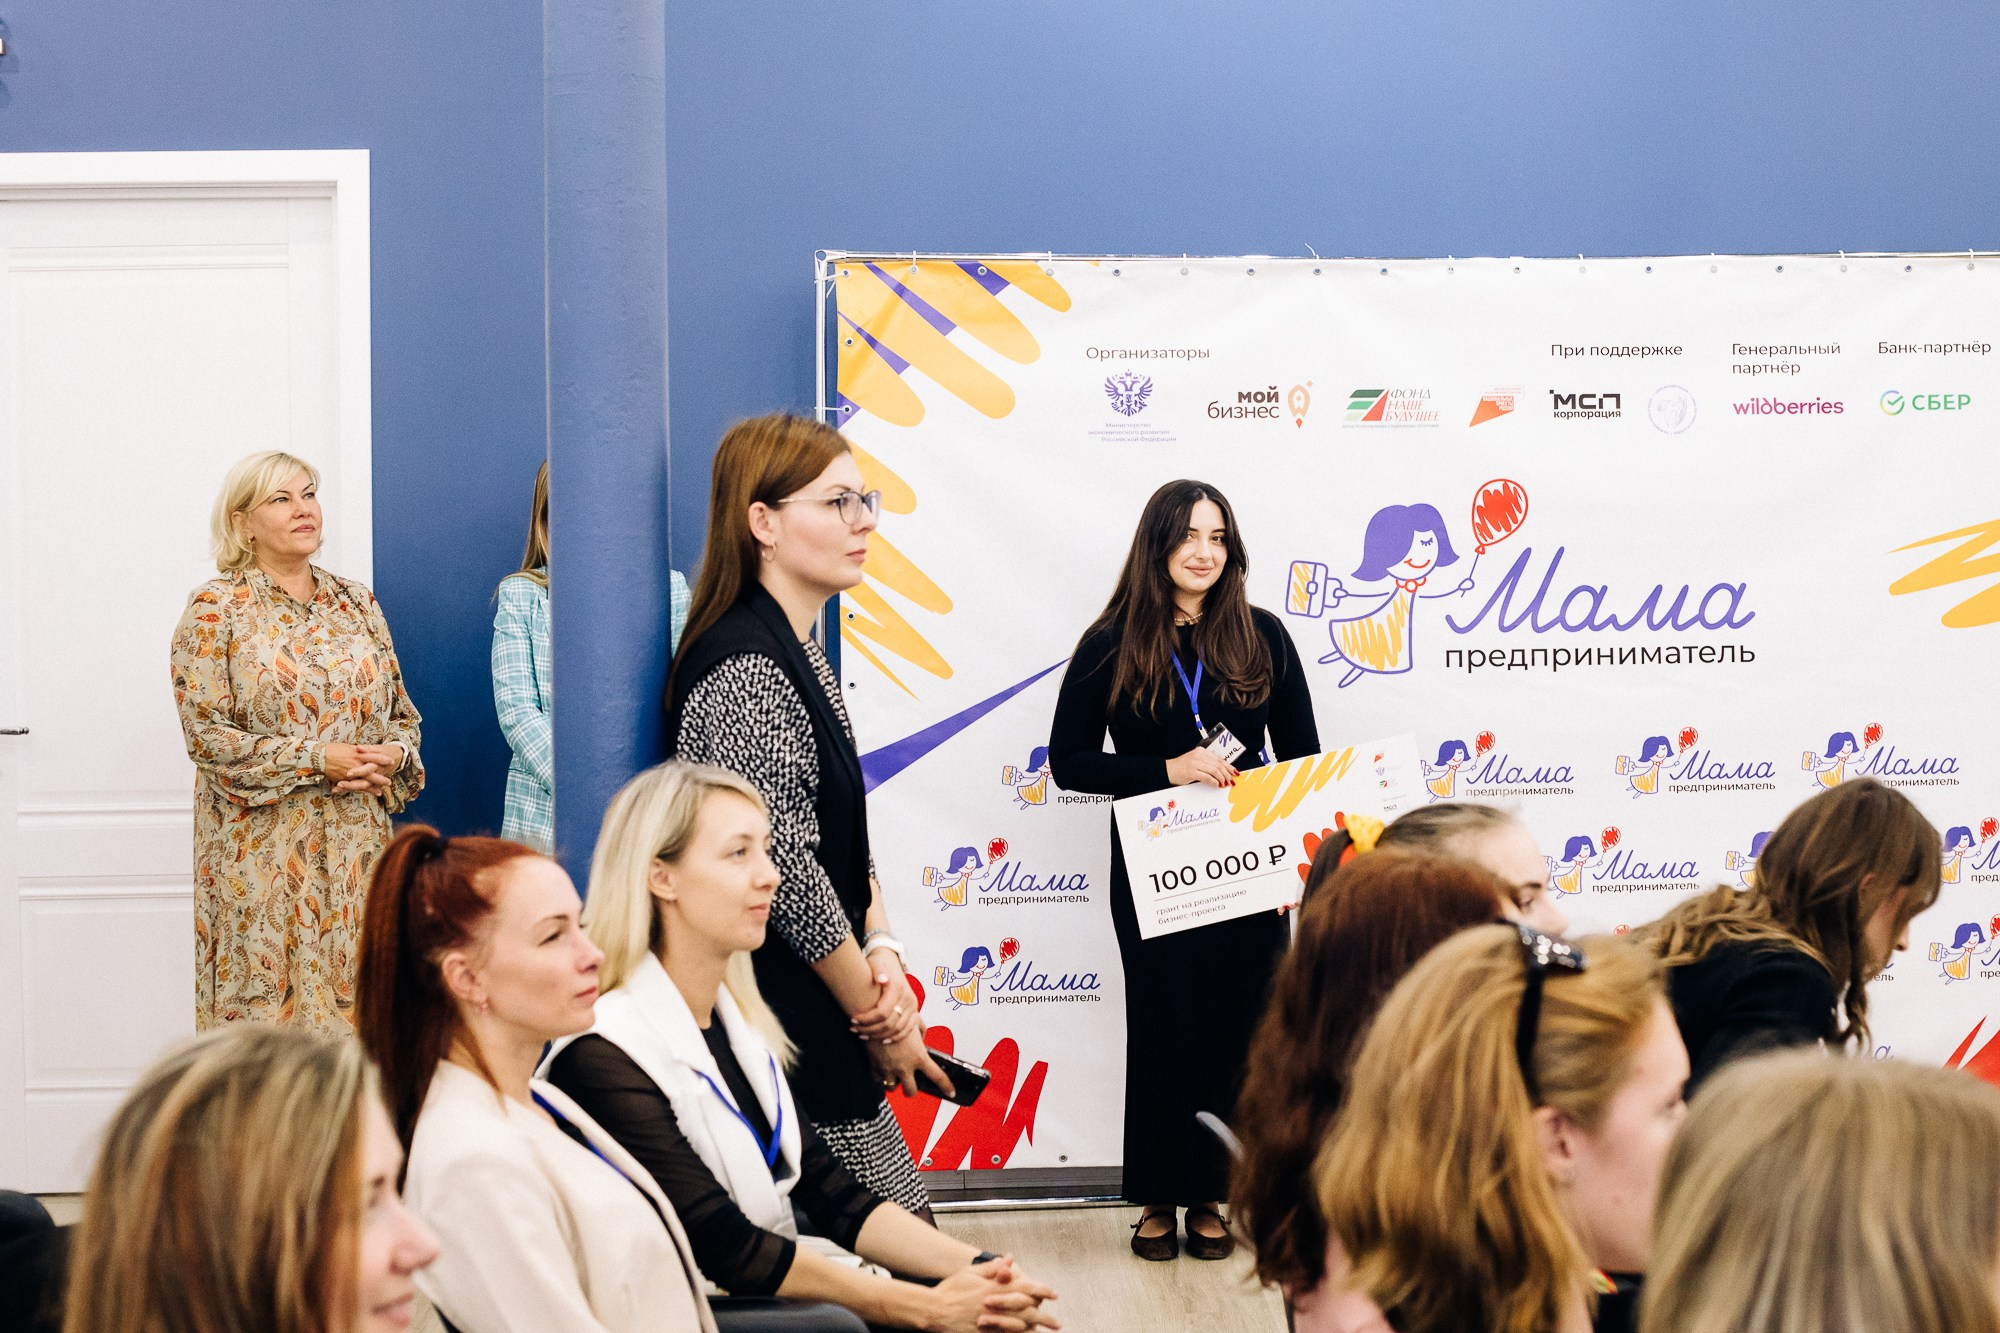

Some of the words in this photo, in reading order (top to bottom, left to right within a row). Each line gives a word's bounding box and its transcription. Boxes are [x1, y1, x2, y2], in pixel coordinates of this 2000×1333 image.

[1085, 346, 1210, 362] Организаторы
[1551, 344, 1585, 360] При
[1590, 345, 1683, 359] поддержке
[1732, 342, 1841, 358] Генеральный
[1878, 340, 1992, 356] Банк-партнёр
[1732, 360, 1801, 377] партнёр
[1390, 388, 1431, 399] ФОНД
[1548, 389, 1621, 410] МСП
[1911, 393, 1972, 411] СБЕР
[1207, 401, 1280, 419] бизнес
[1387, 400, 1424, 411] НАШЕ
[1732, 396, 1845, 415] wildberries
[1384, 411, 1440, 422] БУДУЩЕЕ
[1553, 410, 1622, 421] корпорация
[1445, 546, 1756, 634] Мама
[1445, 643, 1756, 673] предприниматель
[1465, 753, 1575, 785] Мама
[1668, 749, 1777, 781] Мама
[1853, 745, 1961, 777] Мама
[1668, 782, 1776, 795] предприниматель
[1884, 778, 1961, 789] приниматель
[1465, 787, 1575, 799] предприниматель
[1168, 807, 1220, 829] Мама
[1148, 865, 1197, 894] 100
[1205, 850, 1260, 880] 000
[1592, 848, 1700, 881] Мама
[978, 861, 1090, 893] Мама
[1592, 882, 1700, 895] предприниматель
[978, 895, 1090, 908] предприниматель
[1156, 905, 1181, 917] грант
[1181, 902, 1194, 911] на
[1193, 889, 1247, 908] реализацию
[1157, 904, 1226, 925] бизнес-проекта
[990, 960, 1101, 992] Мама
[989, 994, 1101, 1007] предприниматель
